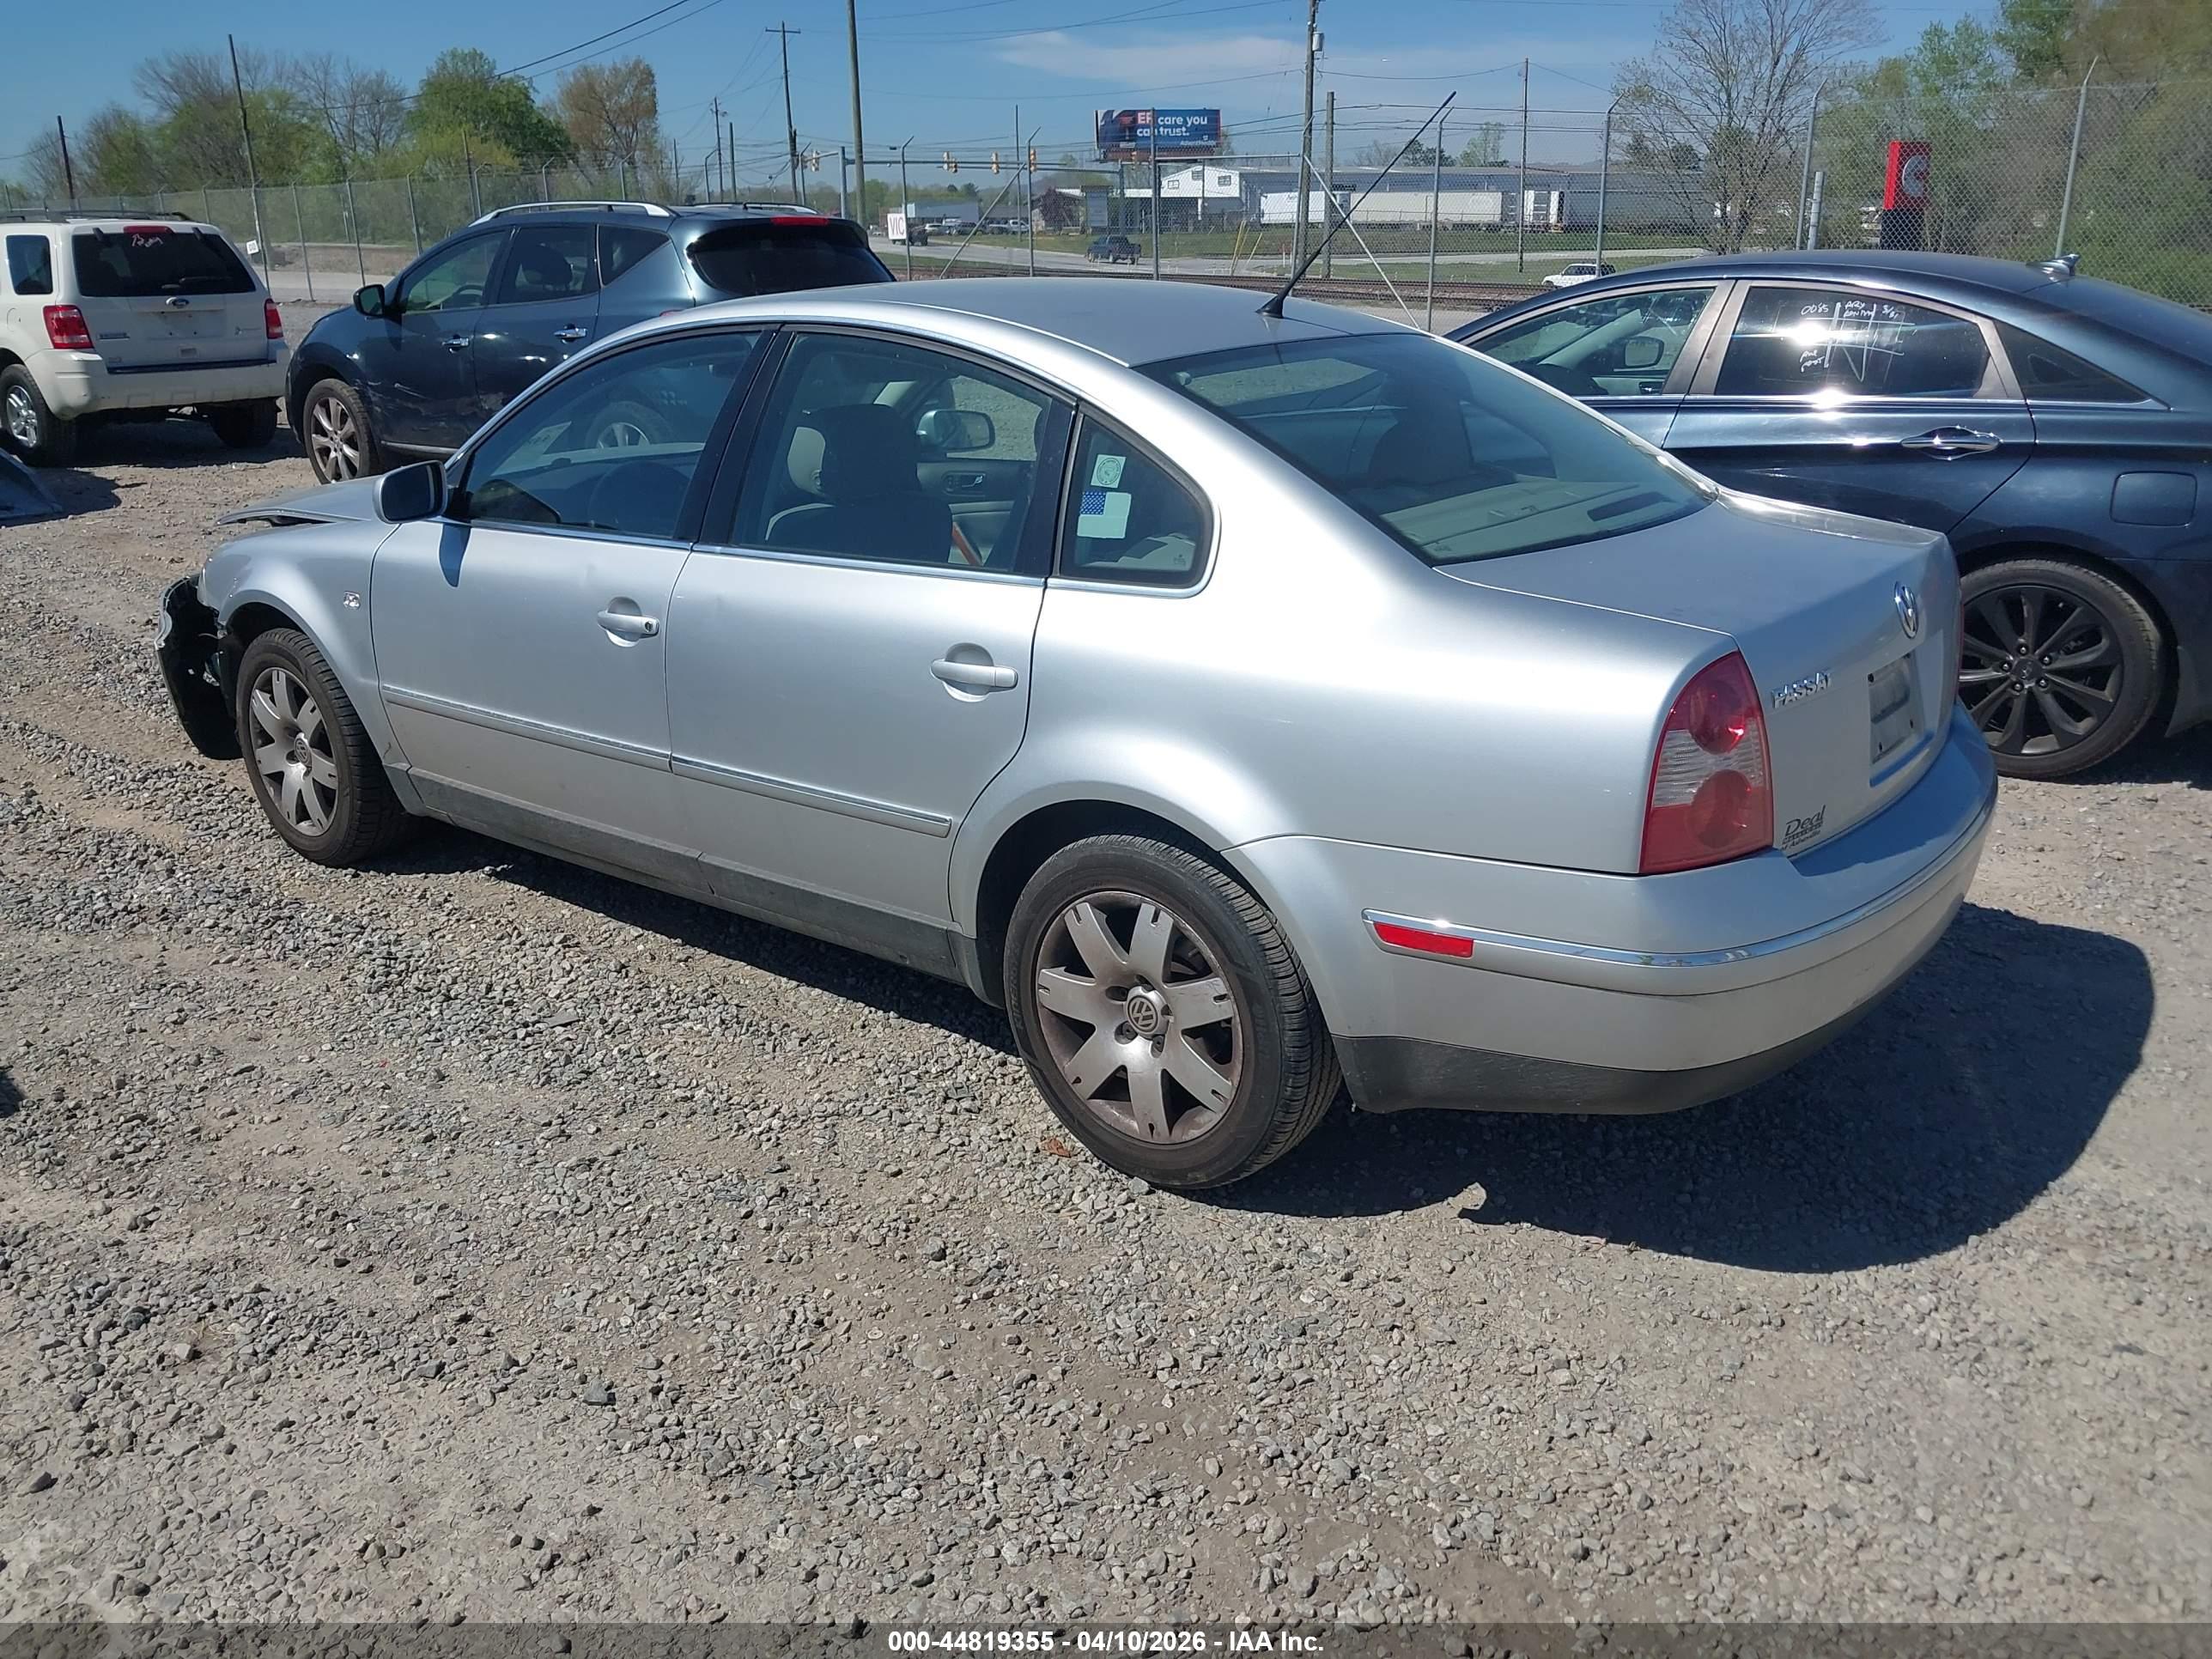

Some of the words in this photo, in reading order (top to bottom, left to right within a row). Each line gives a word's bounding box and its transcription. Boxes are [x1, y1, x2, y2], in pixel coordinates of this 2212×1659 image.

[1187, 116, 1207, 127] you
[1159, 126, 1189, 137] trust.
[889, 215, 904, 229] VIC
[1771, 672, 1832, 709] PASSAT
[1784, 805, 1826, 836] Deal
